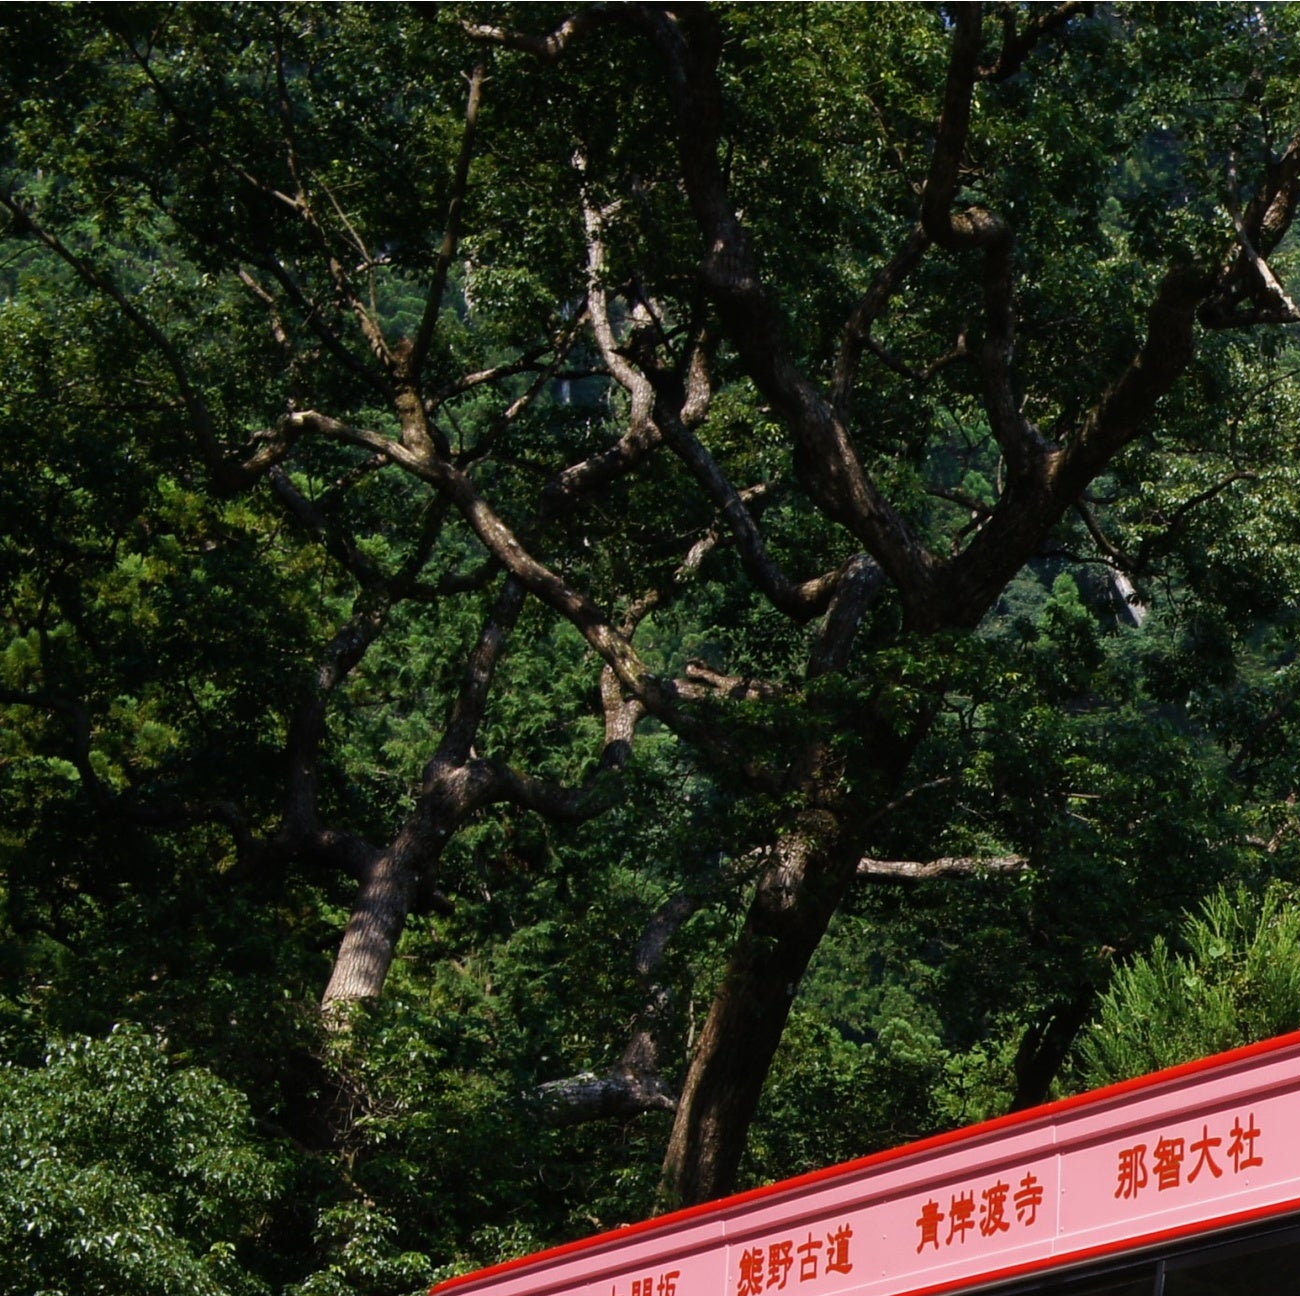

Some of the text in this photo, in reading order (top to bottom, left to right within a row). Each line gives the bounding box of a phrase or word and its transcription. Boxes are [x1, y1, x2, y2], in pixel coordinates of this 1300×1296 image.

[916, 1171, 1043, 1254] 青岸渡寺
[1115, 1113, 1263, 1199] 那智大社
